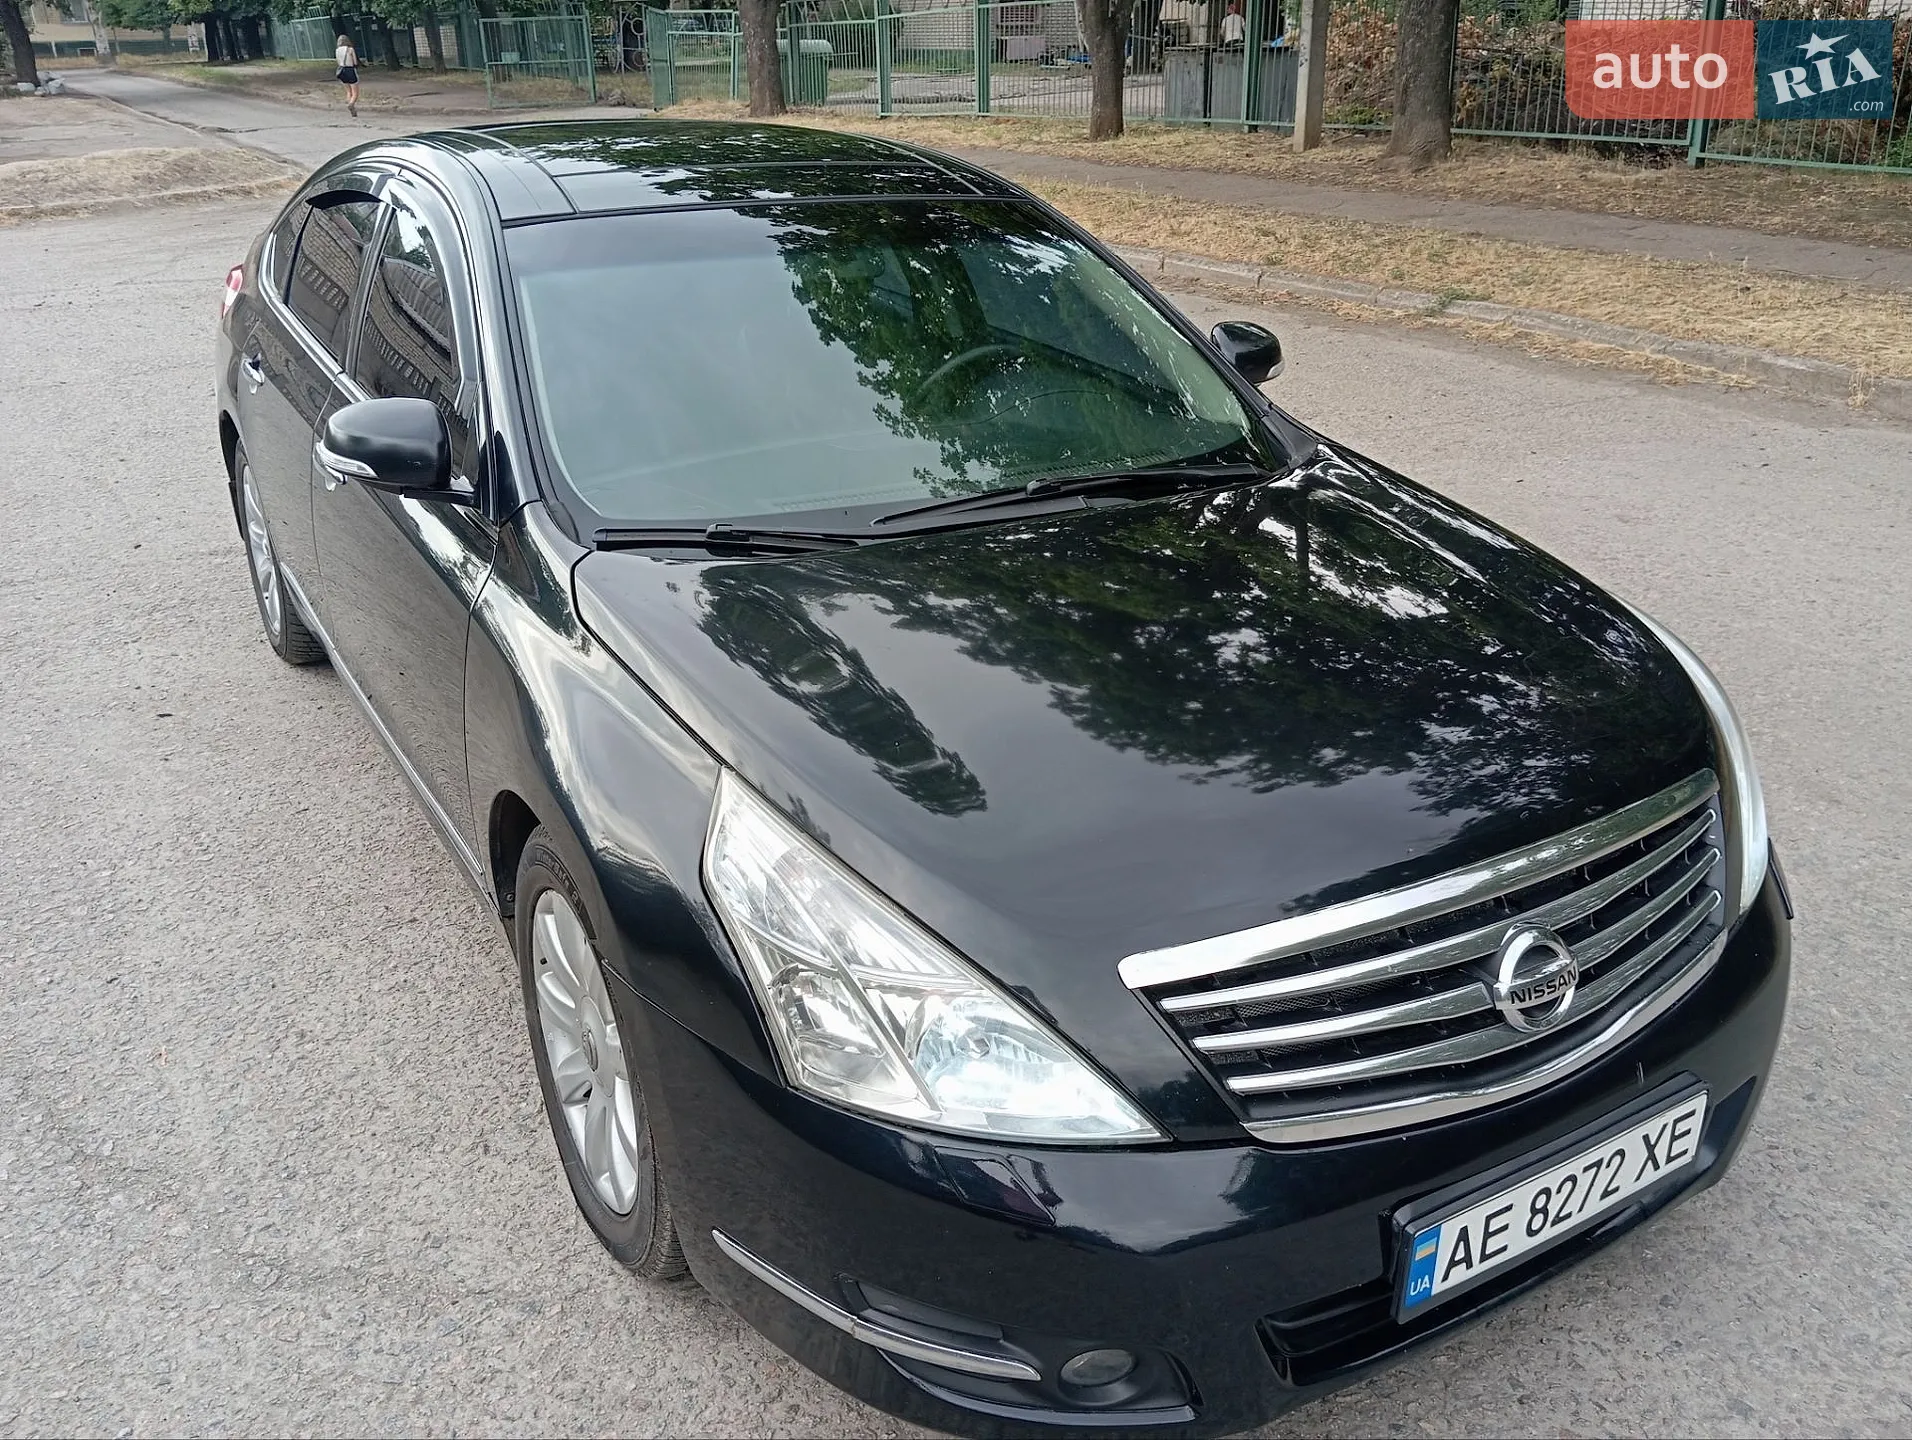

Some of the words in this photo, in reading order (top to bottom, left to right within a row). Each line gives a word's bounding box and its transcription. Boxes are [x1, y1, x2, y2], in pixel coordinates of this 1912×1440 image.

[1510, 965, 1577, 1004] NISSAN
[1441, 1203, 1513, 1283] AE
[1525, 1148, 1626, 1238] 8272
[1634, 1108, 1697, 1183] XE
[1410, 1274, 1430, 1296] UA
